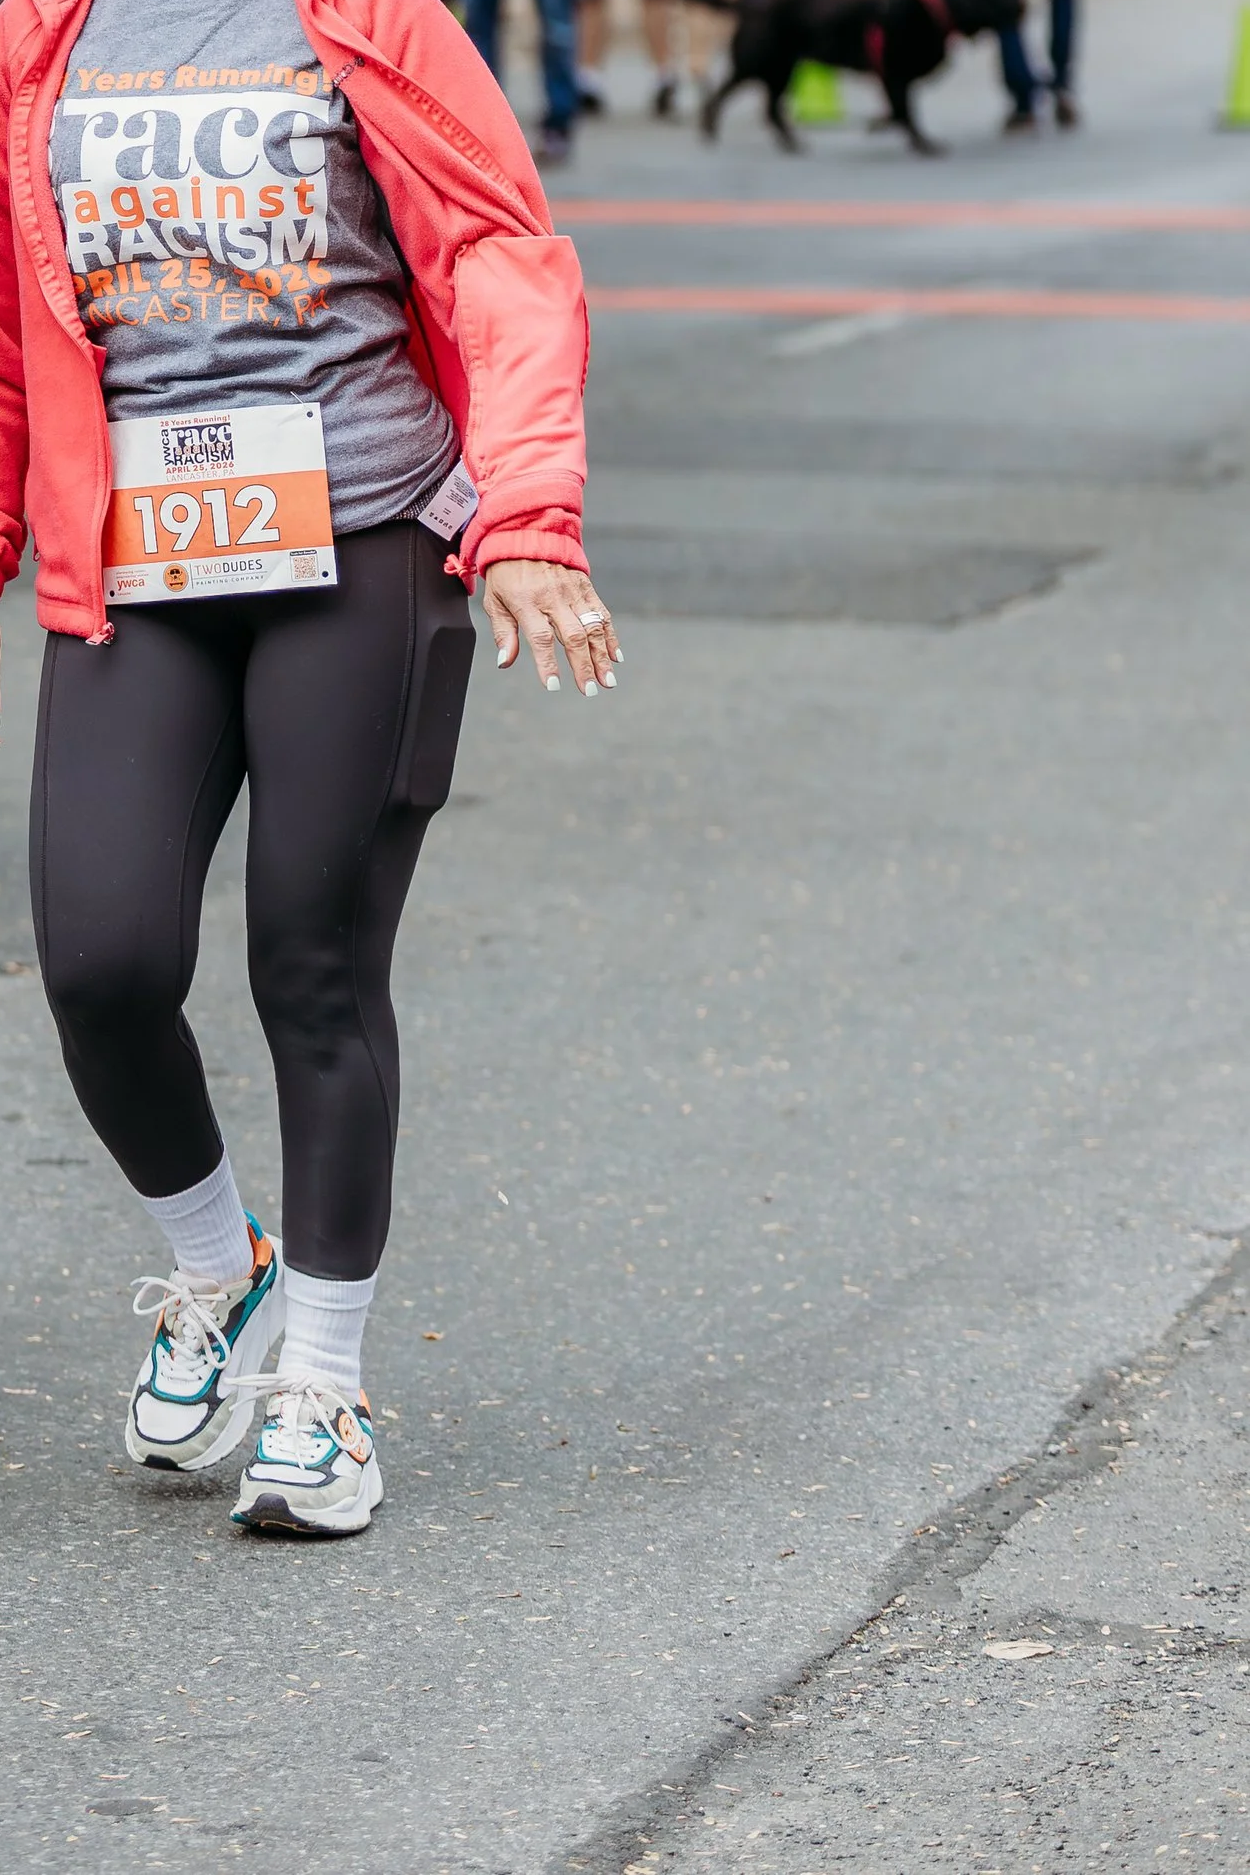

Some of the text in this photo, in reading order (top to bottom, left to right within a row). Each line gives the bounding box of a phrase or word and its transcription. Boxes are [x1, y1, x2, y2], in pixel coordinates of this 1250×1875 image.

[77, 68, 166, 92] Years
[175, 63, 333, 96] Running!
[62, 104, 330, 182] race
[73, 176, 315, 230] against
[66, 217, 329, 274] RACISM
[72, 258, 332, 298] PRIL 25, 2026
[86, 288, 330, 327] NCASTER, PA
[171, 424, 232, 446] race
[193, 414, 231, 423] Running!
[161, 428, 175, 466] ywca
[173, 448, 234, 466] RACISM
[166, 461, 235, 475] APRIL 25, 2026
[223, 468, 236, 476] PA
[134, 484, 280, 554] 1912
[117, 578, 145, 591] ywca
[196, 578, 229, 586] PAINTING
